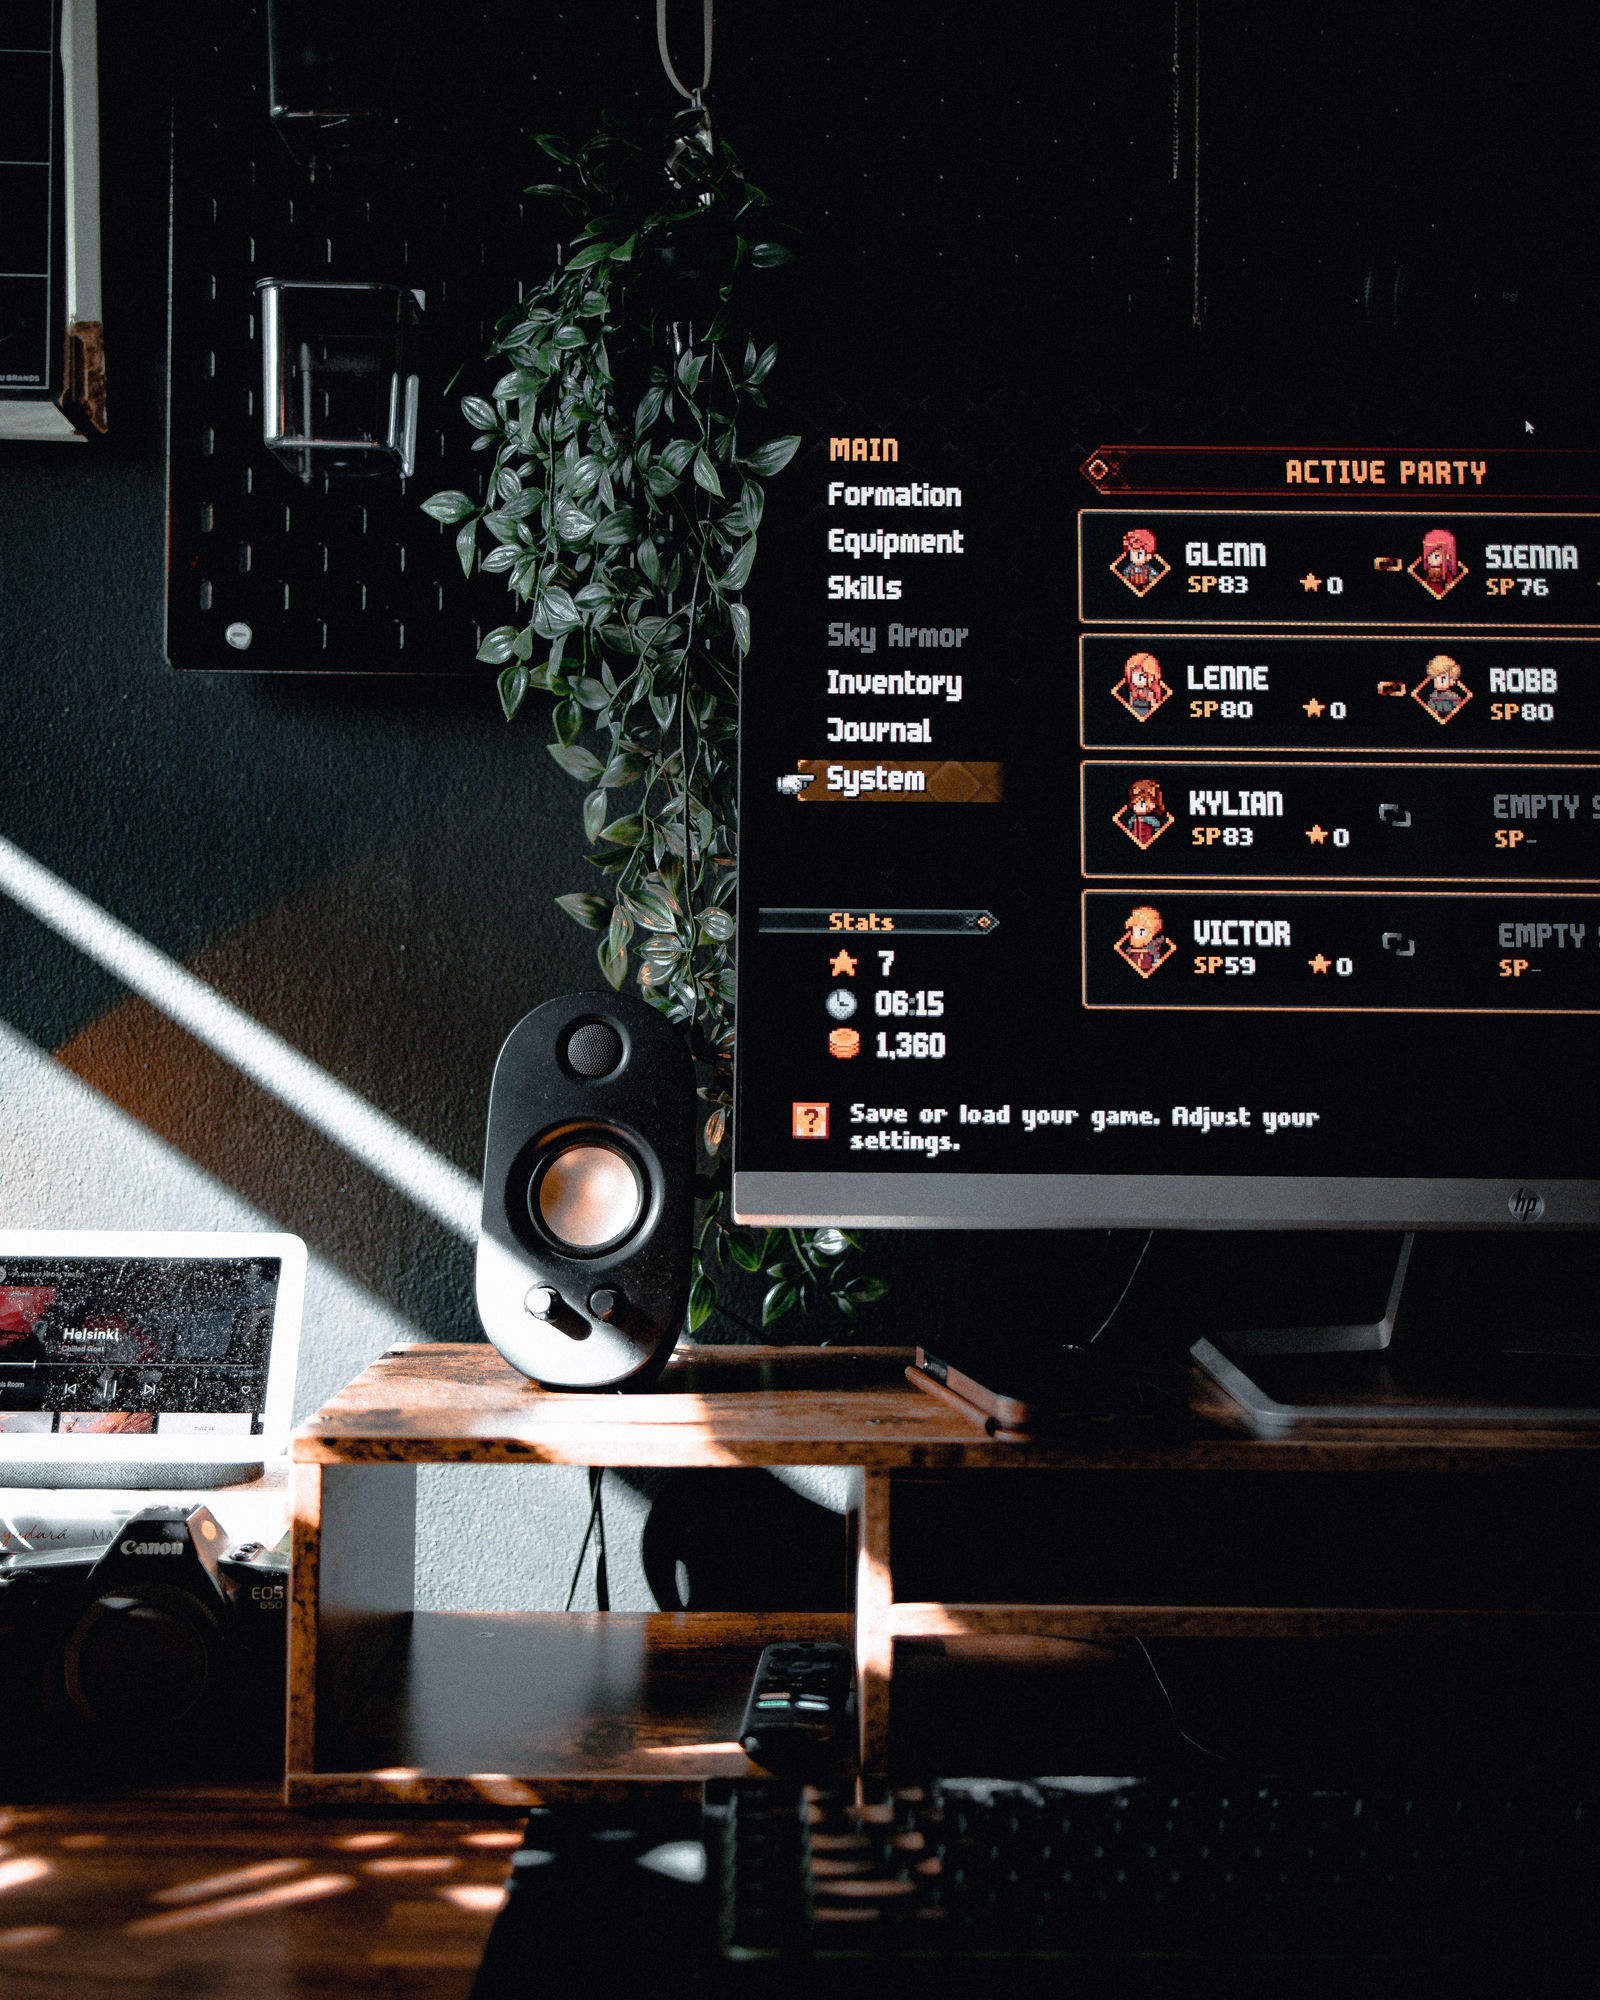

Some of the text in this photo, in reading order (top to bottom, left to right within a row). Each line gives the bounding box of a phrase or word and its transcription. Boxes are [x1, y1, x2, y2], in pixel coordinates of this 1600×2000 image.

[830, 438, 898, 462] MAIN
[1286, 460, 1486, 484] ACTIVE PARTY
[829, 482, 961, 507] Formation
[828, 528, 964, 559] Equipment
[1186, 542, 1266, 567] GLENN
[1486, 545, 1578, 569] SIENNA
[828, 575, 902, 600] Skills
[1327, 577, 1343, 594] 0
[828, 623, 968, 653] Sky Armor
[827, 670, 962, 702] Inventory
[1187, 666, 1268, 690] LENNE
[1490, 668, 1557, 693] ROBB
[1330, 702, 1346, 719] 0
[827, 717, 932, 742] Journal
[827, 765, 925, 796] System
[1190, 791, 1283, 816] KYLIAN
[1494, 794, 1579, 819] EMPTY
[1333, 829, 1349, 847] 0
[829, 913, 894, 931] Stats
[1194, 920, 1291, 946] VICTOR
[1499, 923, 1585, 948] EMPTY
[878, 951, 894, 976] 7
[1336, 958, 1352, 976] 0
[875, 990, 944, 1017] 06:15
[876, 1032, 946, 1060] 1,360
[850, 1104, 1320, 1134] Save or load your game. Adjust your
[850, 1131, 960, 1158] settings.
[1513, 1187, 1538, 1222] hp
[63, 1327, 119, 1340] Helsinki
[121, 1540, 184, 1555] Canon
[251, 1585, 284, 1600] EOS
